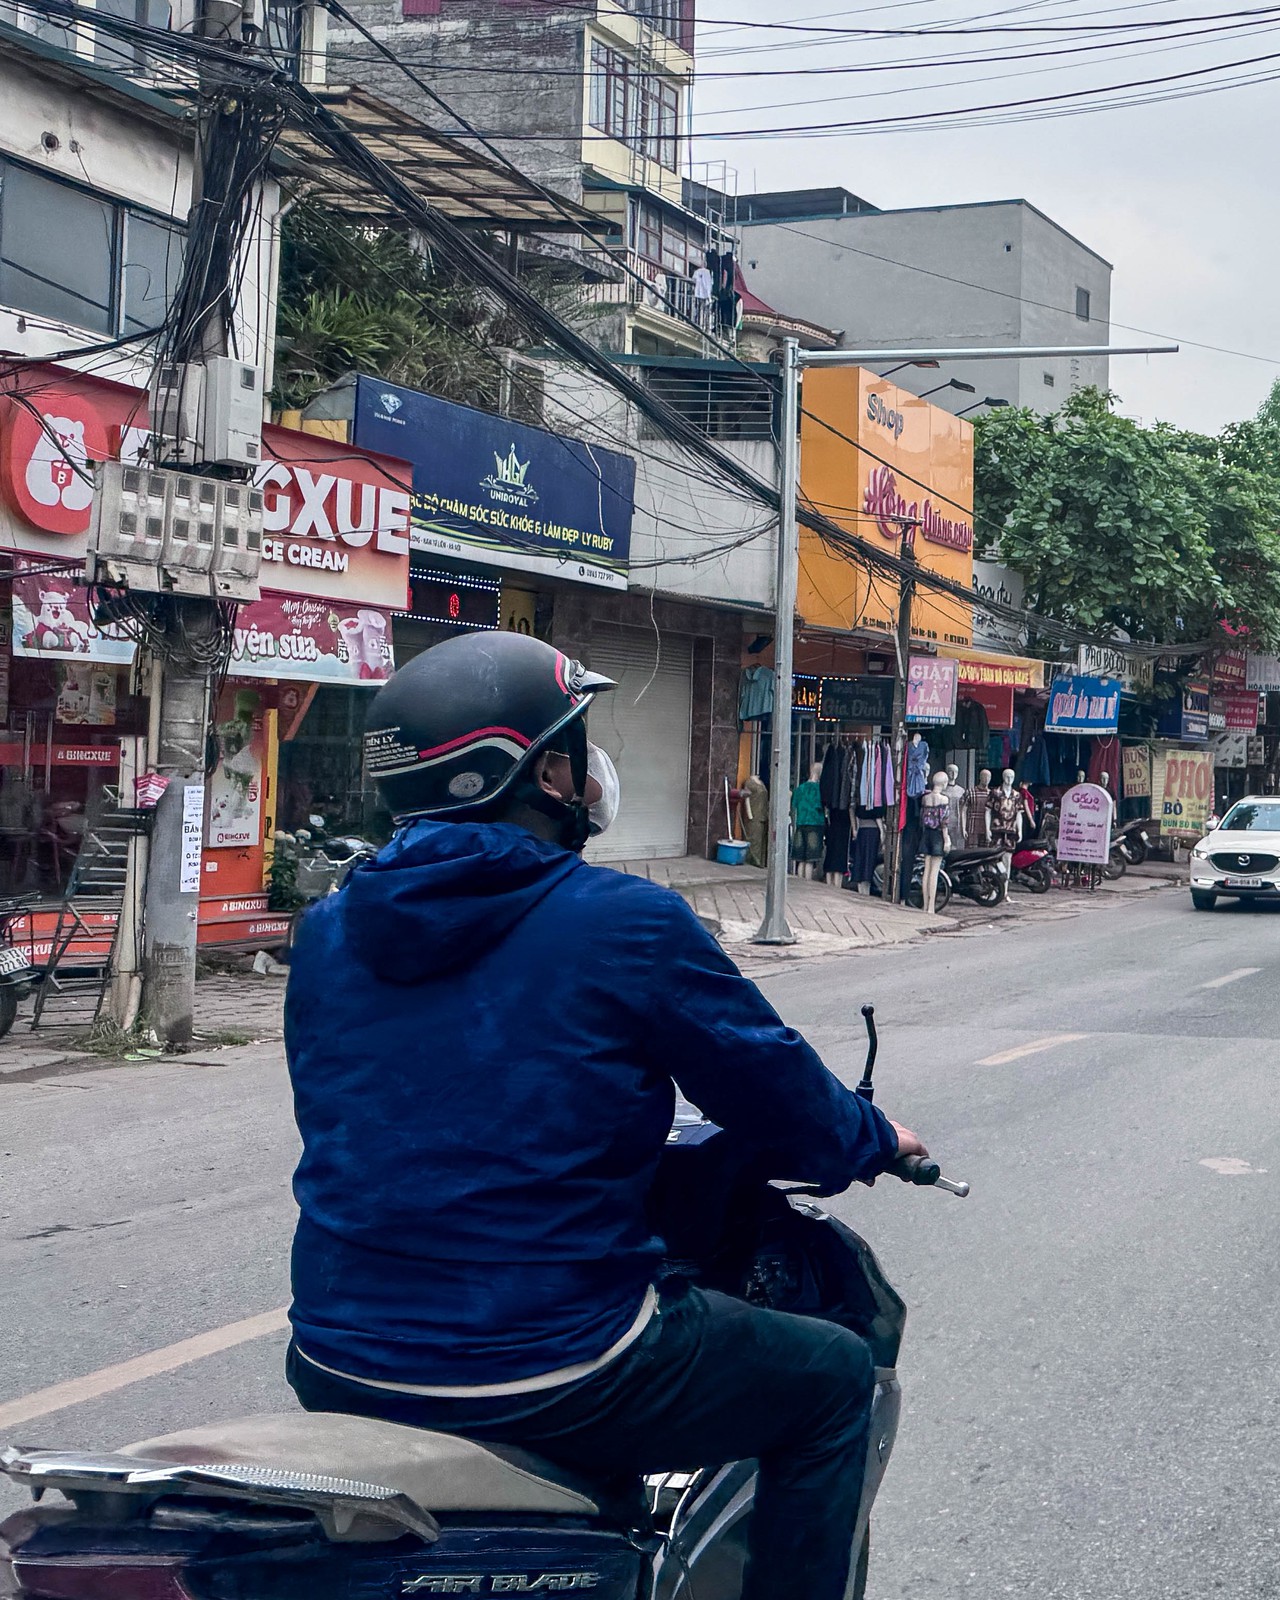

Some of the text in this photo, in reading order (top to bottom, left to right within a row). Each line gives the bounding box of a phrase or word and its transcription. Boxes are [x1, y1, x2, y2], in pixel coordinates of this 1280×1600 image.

[867, 393, 903, 439] Shop
[262, 461, 411, 555] GXUE
[490, 490, 528, 507] UNIROYAL
[469, 504, 489, 523] SÓC
[543, 521, 561, 539] LÀM
[562, 528, 579, 545] ĐẸP
[582, 532, 592, 546] LY
[592, 535, 614, 551] RUBY
[262, 540, 349, 573] CE CREAM
[233, 622, 275, 662] yện
[910, 662, 953, 683] GIẶT
[1163, 799, 1183, 816] BÒ
[256, 922, 289, 933] BINGXU
[402, 1572, 599, 1592] AIR BLADE
